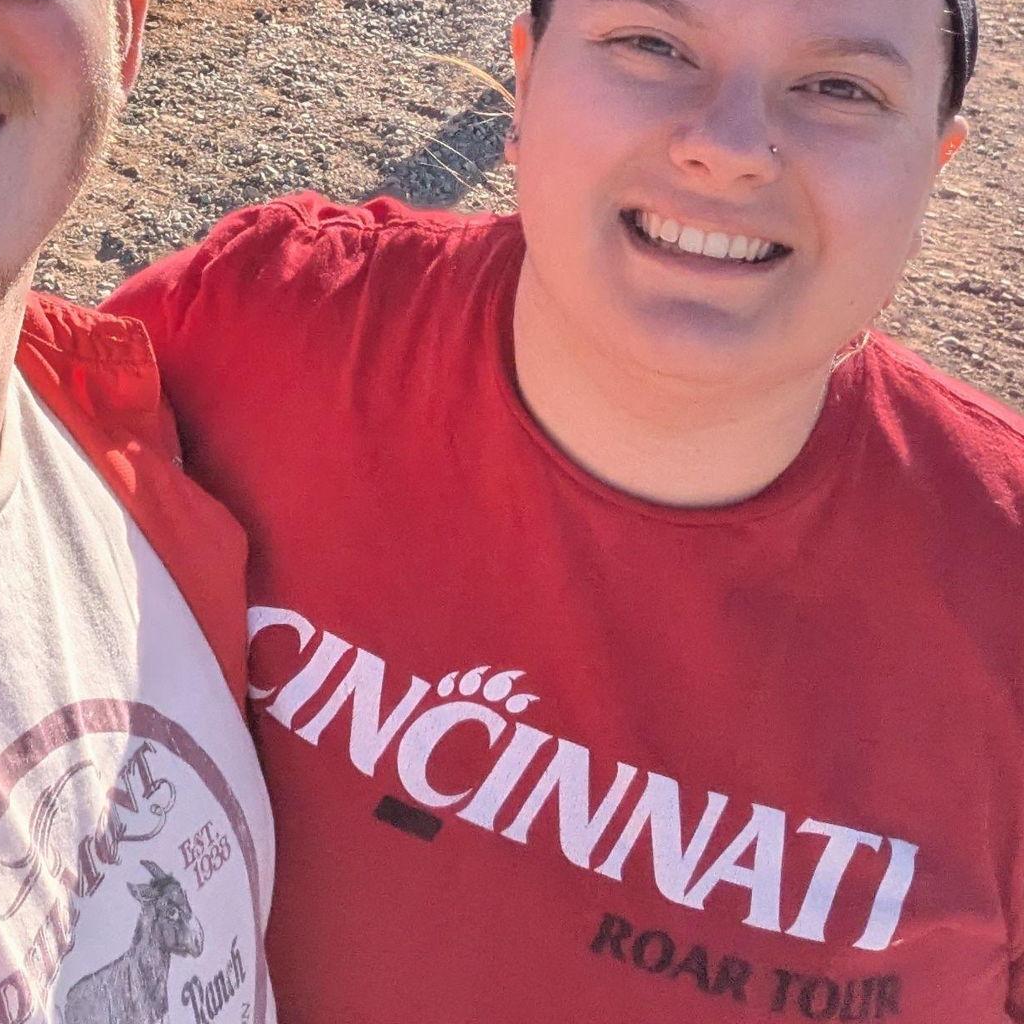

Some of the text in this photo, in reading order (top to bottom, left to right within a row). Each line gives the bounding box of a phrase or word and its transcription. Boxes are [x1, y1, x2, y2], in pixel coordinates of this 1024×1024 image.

[247, 606, 919, 951] CINCINNATI
[590, 912, 903, 1021] ROAR TOUR
